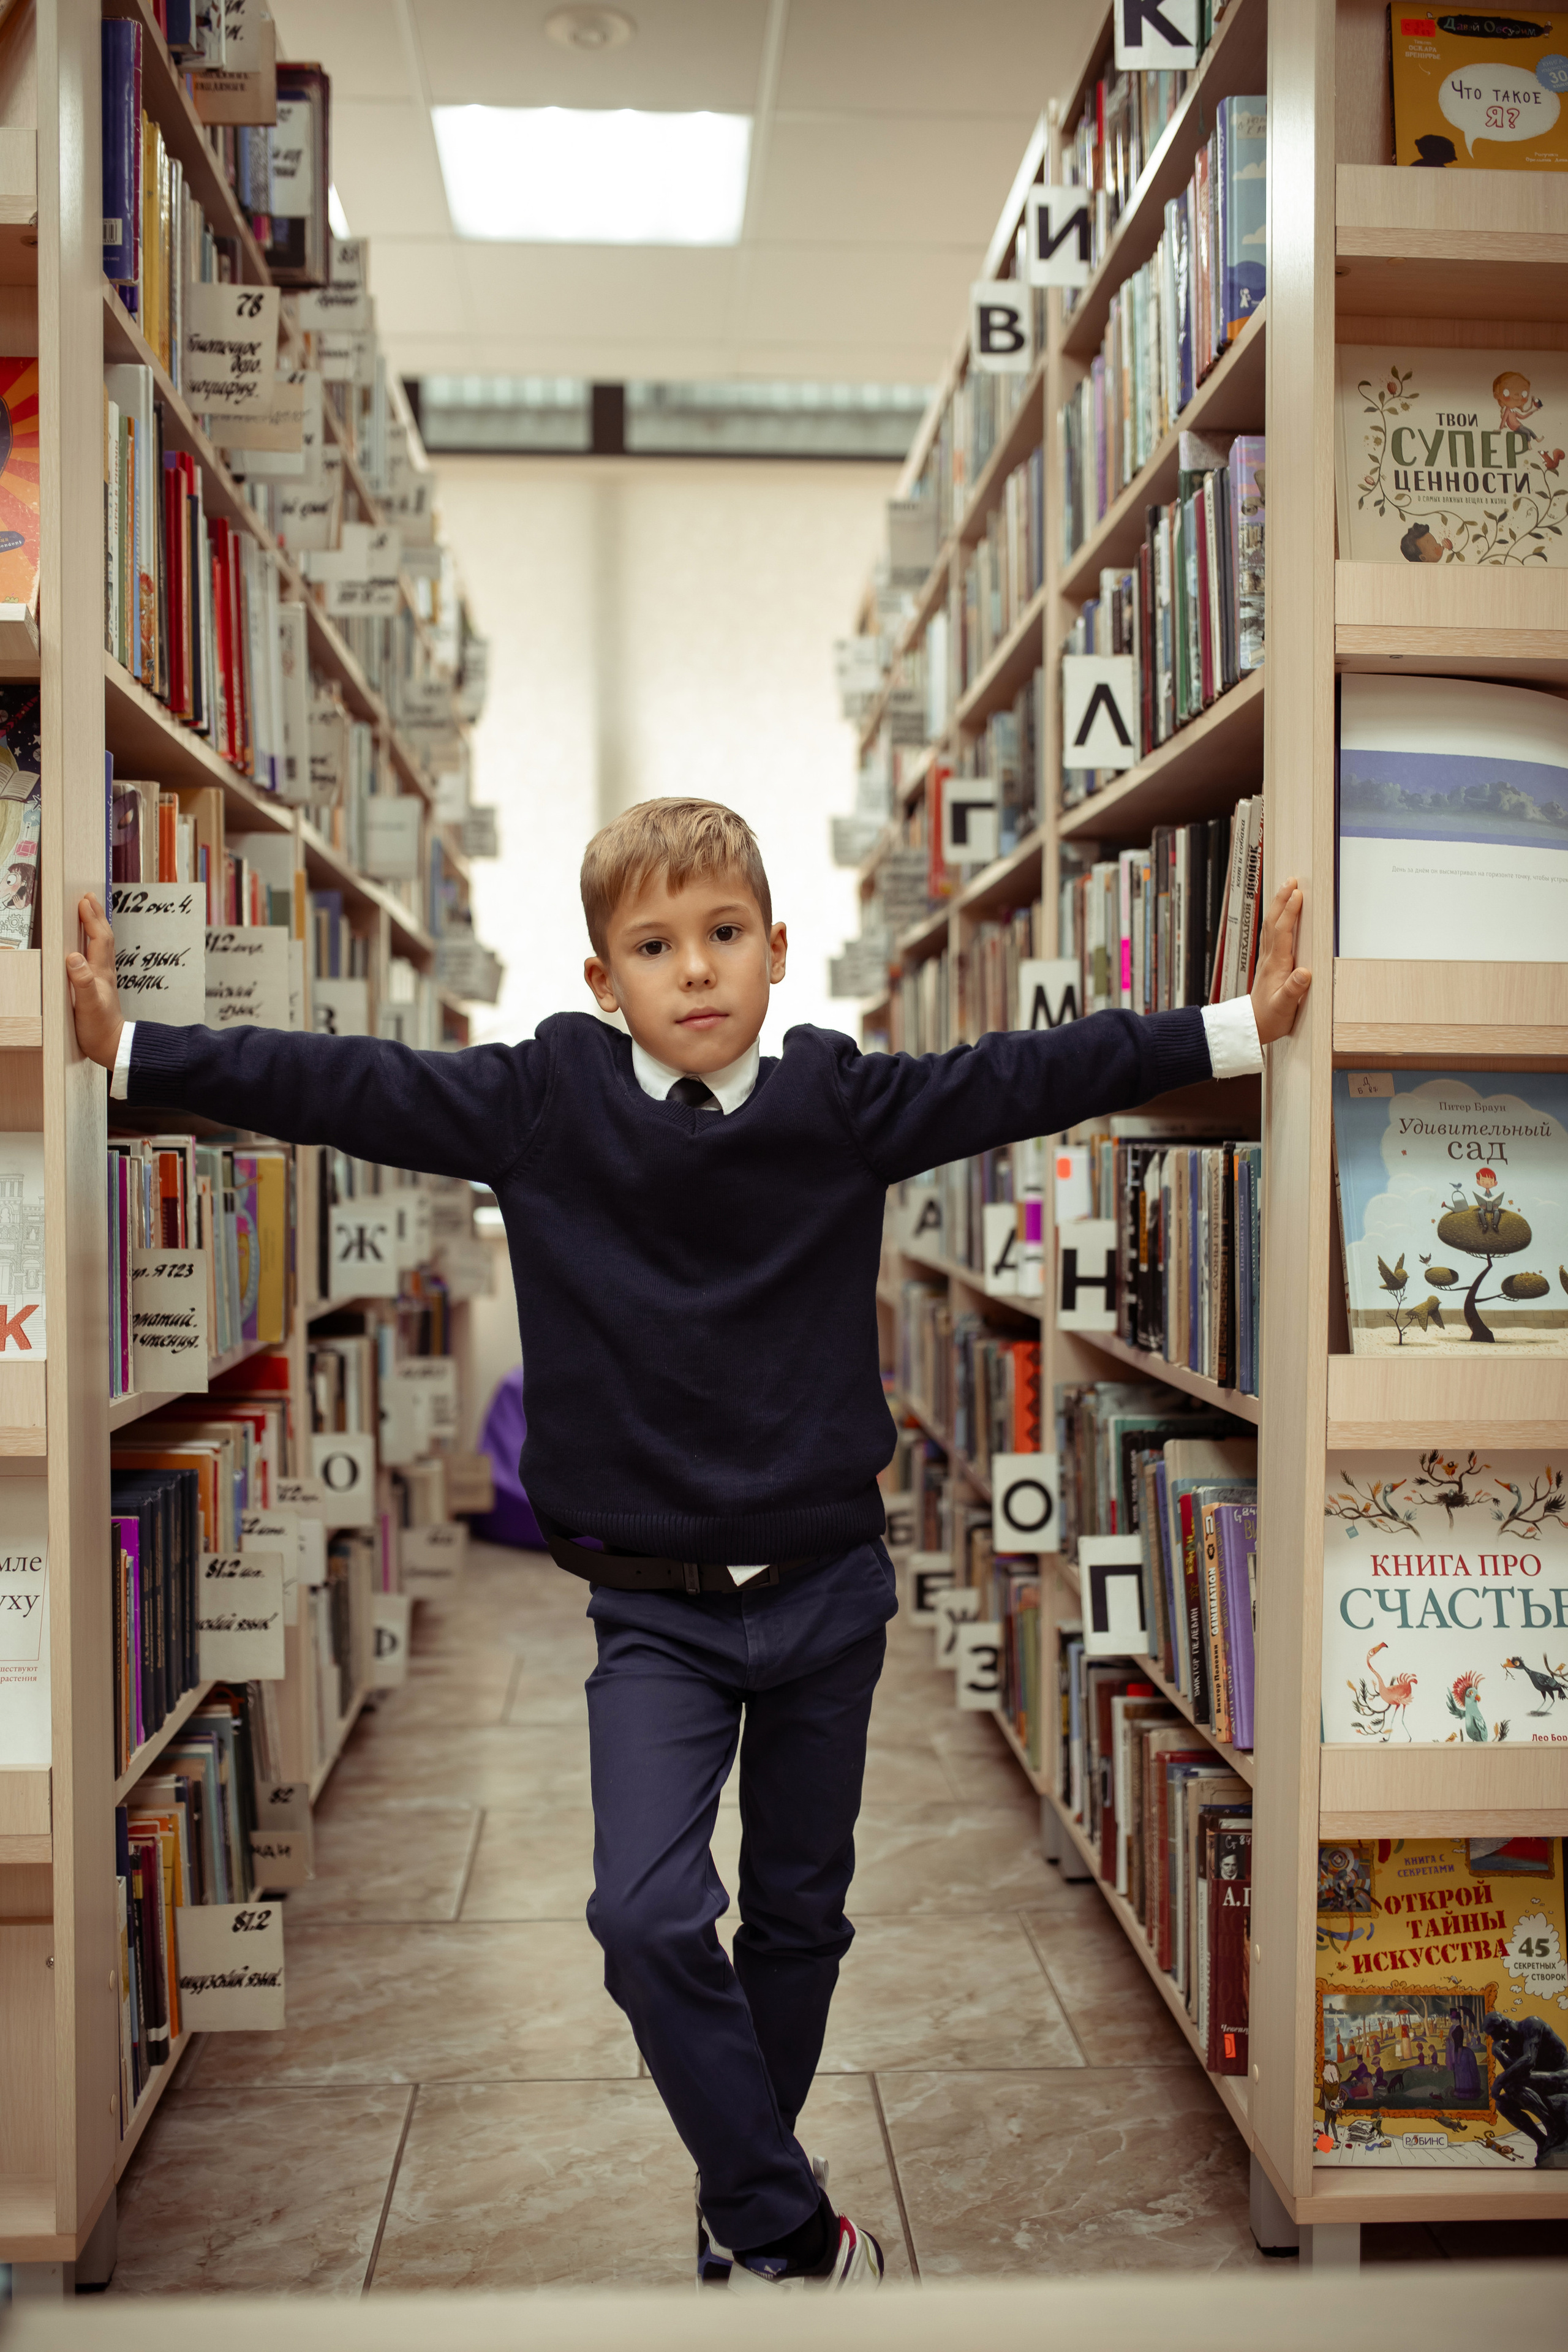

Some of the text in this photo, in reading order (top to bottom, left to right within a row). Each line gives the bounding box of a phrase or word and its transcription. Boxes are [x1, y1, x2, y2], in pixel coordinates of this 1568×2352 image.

[1549, 70, 1567, 84] 30
[1485, 105, 1520, 129] Я?
[1038, 205, 1088, 260] И
[237, 293, 264, 317] 78
[980, 306, 1025, 353] В
[1436, 413, 1478, 428] ТВОИ
[1391, 426, 1530, 469] СУПЕР
[1394, 470, 1531, 494] ЦЕННОСТИ
[1072, 684, 1133, 745] Л
[952, 802, 995, 845] Г
[1245, 843, 1259, 900] ЗВОНОК
[1240, 903, 1251, 973] МИХАЛКОВ
[1032, 984, 1077, 1030] М
[1439, 1102, 1506, 1113] Питер Браун
[1399, 1118, 1552, 1137] Удивительный
[1447, 1140, 1509, 1165] сад
[336, 1224, 387, 1262] Ж
[1061, 1249, 1116, 1311] Н
[322, 1450, 360, 1493] О
[1003, 1479, 1053, 1532] О
[1370, 1554, 1542, 1577] КНИГА ПРО
[1090, 1564, 1147, 1632] П
[1207, 1567, 1219, 1637] GENERATION
[1340, 1585, 1568, 1629] СЧАСТЬЕ
[1189, 1607, 1201, 1697] ВИКТОР ПЕЛЕВИН
[1397, 1864, 1455, 1878] СЕКРЕТАМИ
[1404, 1856, 1437, 1866] КНИГА
[1384, 1880, 1493, 1915] ОТКРОЙ
[1406, 1910, 1507, 1940] ТАЙНЫ
[1351, 1937, 1510, 1974] ИСКУССТВА
[1513, 1961, 1556, 1970] СЕКРЕТНЫХ
[1518, 1937, 1551, 1958] 45
[1531, 1973, 1566, 1981] СТВОРОК
